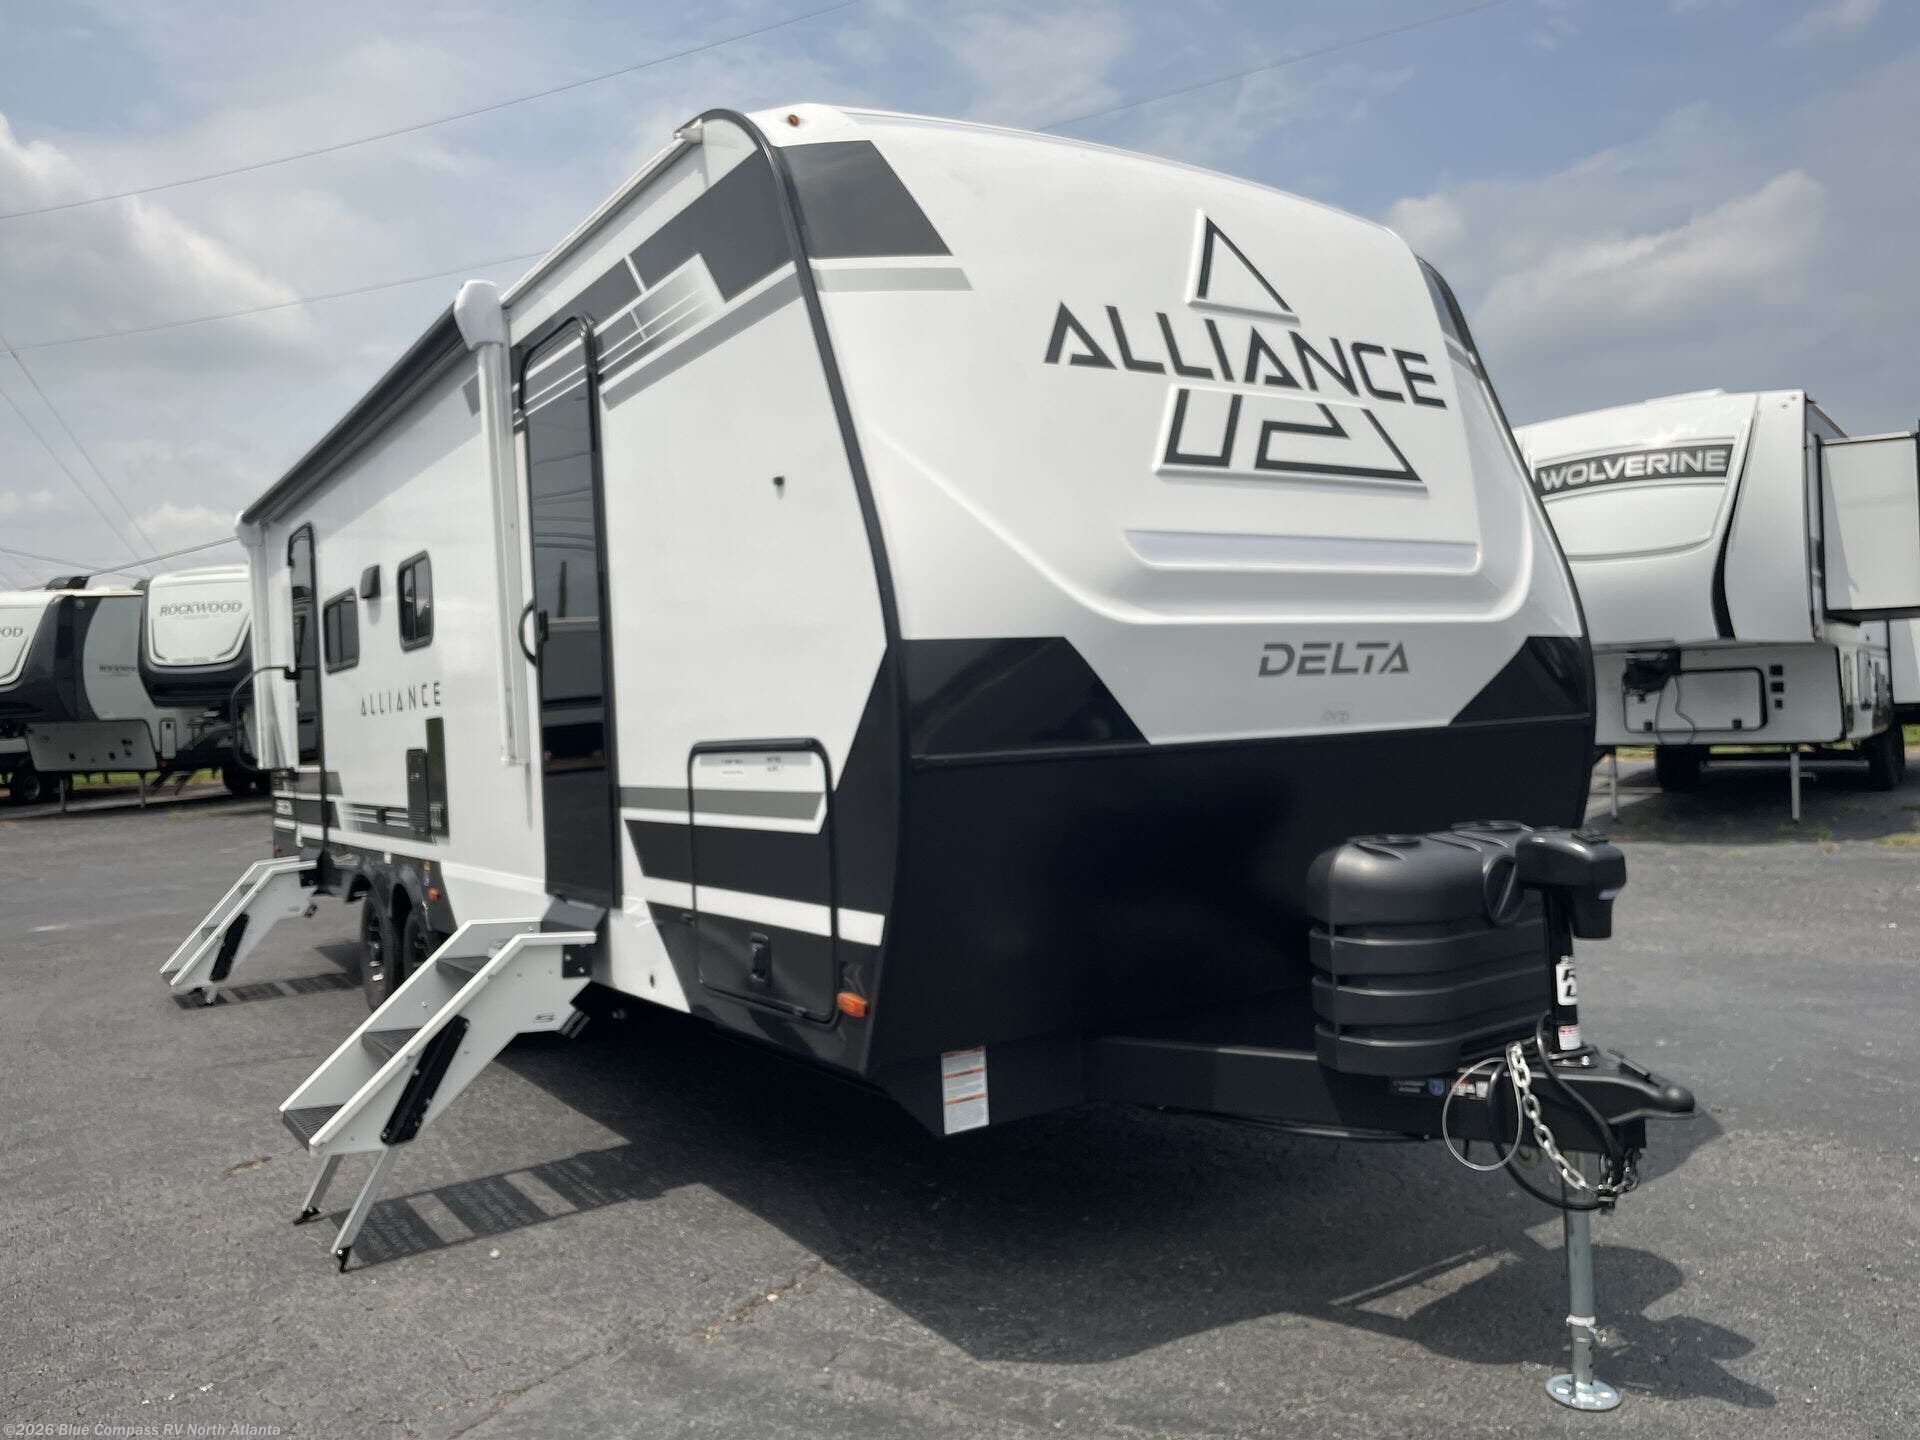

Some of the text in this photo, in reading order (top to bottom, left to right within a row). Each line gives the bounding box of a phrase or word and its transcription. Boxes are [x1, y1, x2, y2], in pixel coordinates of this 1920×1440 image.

[1043, 301, 1447, 410] ALLIANCE
[1538, 447, 1728, 491] WOLVERINE
[159, 600, 243, 617] ROCKWOOD
[1258, 641, 1410, 677] DELTA
[360, 680, 441, 717] ALLIANCE
